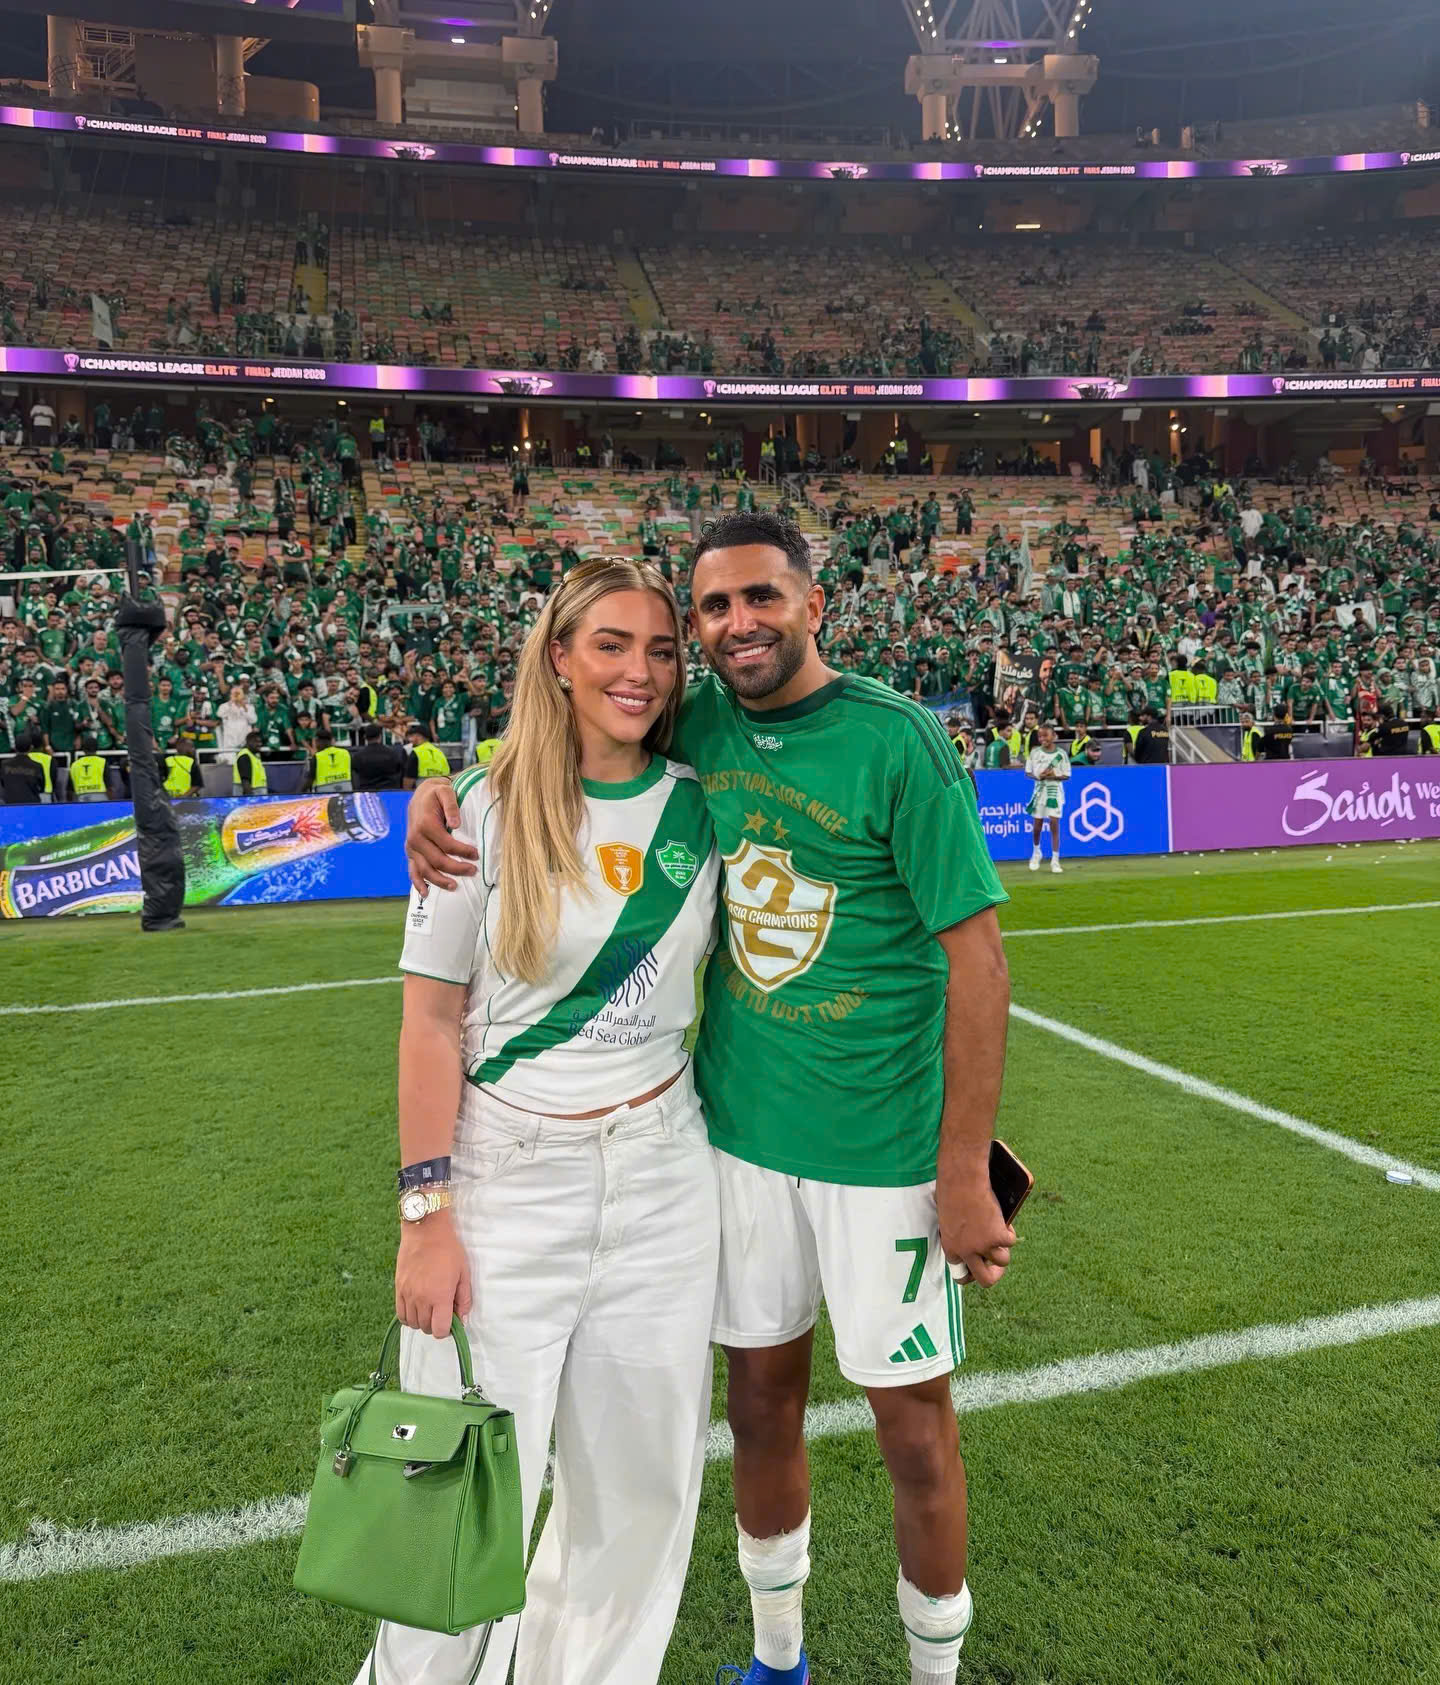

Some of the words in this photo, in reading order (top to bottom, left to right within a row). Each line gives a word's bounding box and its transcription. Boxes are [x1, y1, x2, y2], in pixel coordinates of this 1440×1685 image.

[91, 119, 143, 133] CHAMPIONS
[143, 125, 178, 136] LEAGUE
[178, 128, 202, 138] ELITE
[562, 155, 607, 166] CHAMPIONS
[608, 157, 638, 168] LEAGUE
[987, 166, 1030, 175] CHAMPIONS
[1030, 166, 1059, 175] LEAGUE
[85, 358, 157, 373] CHAMPIONS
[158, 362, 204, 375] LEAGUE
[205, 364, 238, 376] ELITE
[720, 385, 780, 395] CHAMPIONS
[781, 385, 819, 395] LEAGUE
[820, 385, 847, 395] ELITE
[1289, 379, 1348, 390] CHAMPIONS
[1348, 378, 1387, 389] LEAGUE
[1387, 378, 1415, 388] ELITE
[15, 850, 141, 910] BARBICAN
[741, 858, 800, 960] 2
[749, 910, 818, 929] CHAMPIONS
[568, 1022, 594, 1039] Red
[596, 1028, 616, 1044] Sea
[619, 1032, 652, 1046] Global
[895, 1236, 928, 1304] 7
